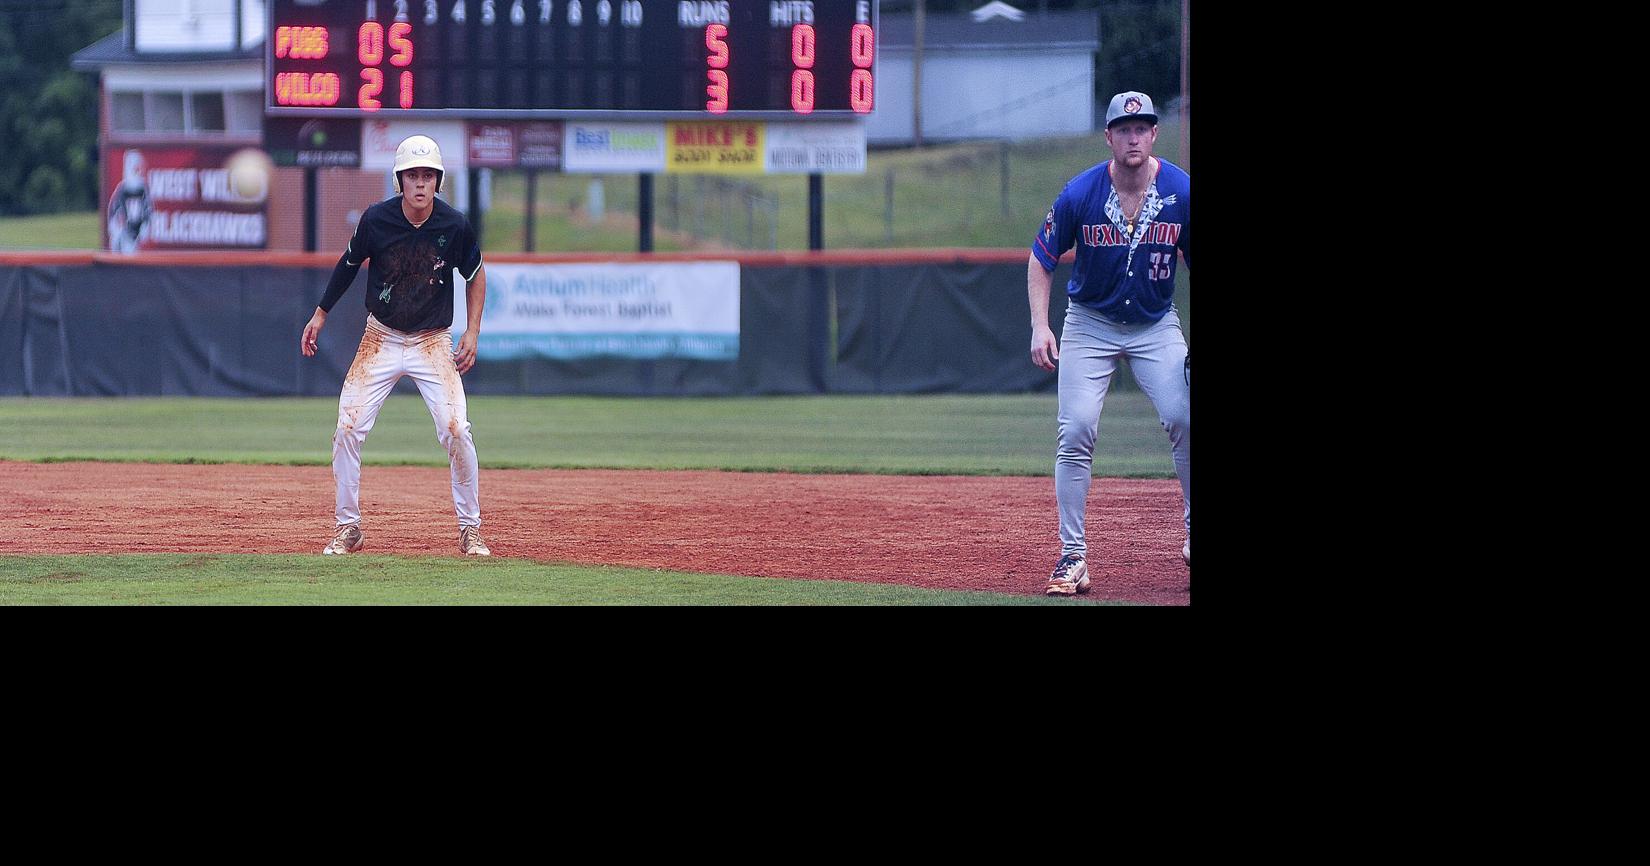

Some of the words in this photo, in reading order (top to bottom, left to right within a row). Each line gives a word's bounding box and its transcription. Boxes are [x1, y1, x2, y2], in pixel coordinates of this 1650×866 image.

[366, 0, 376, 21] 1
[394, 0, 409, 22] 2
[424, 0, 438, 24] 3
[452, 0, 466, 24] 4
[481, 0, 495, 25] 5
[511, 0, 525, 25] 6
[539, 0, 553, 24] 7
[567, 0, 582, 26] 8
[597, 0, 611, 26] 9
[621, 0, 643, 26] 10
[678, 0, 730, 27] RUNS
[770, 0, 814, 27] HITS
[855, 1, 870, 24] E
[358, 22, 384, 65] 0
[388, 22, 414, 67] 5
[705, 24, 729, 69] 5
[791, 24, 815, 69] 0
[851, 24, 874, 68] 0
[358, 68, 384, 112] 2
[400, 71, 414, 110] 1
[705, 69, 729, 114] 3
[791, 69, 814, 114] 0
[851, 69, 874, 113] 0
[673, 125, 758, 146] MIKE'S
[147, 168, 198, 200] WEST
[513, 301, 556, 317] Wake
[563, 301, 611, 317] Forest
[617, 301, 673, 319] Baptist
